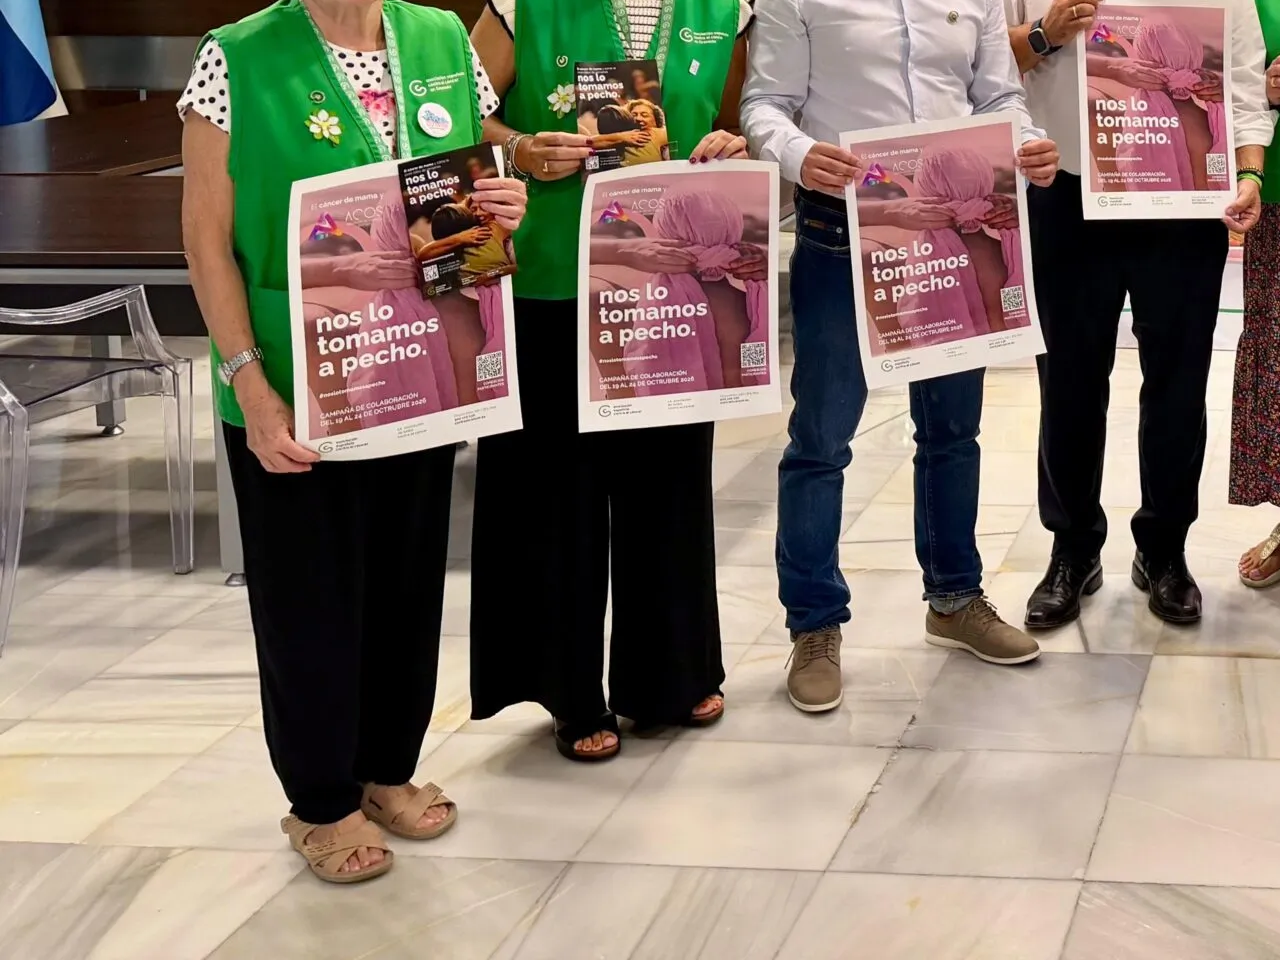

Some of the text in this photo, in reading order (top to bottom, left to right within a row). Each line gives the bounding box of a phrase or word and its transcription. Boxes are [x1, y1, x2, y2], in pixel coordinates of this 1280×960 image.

[577, 73, 606, 82] nos lo
[578, 82, 624, 91] tomamos
[587, 90, 621, 101] pecho.
[1095, 96, 1147, 111] nos lo
[1095, 113, 1178, 127] tomamos
[1096, 129, 1170, 147] a pecho.
[405, 170, 439, 185] nos lo
[407, 175, 460, 196] tomamos
[409, 187, 457, 205] a pecho.
[871, 240, 932, 263] nos lo
[872, 254, 968, 282] tomamos
[600, 283, 667, 303] nos lo
[874, 275, 960, 302] a pecho.
[316, 303, 392, 332] nos lo
[599, 303, 706, 323] tomamos
[316, 318, 436, 354] tomamos
[599, 321, 695, 346] a pecho.
[318, 343, 425, 376] a pecho.
[599, 374, 629, 382] CAMPAÑA
[638, 369, 687, 379] COLABORACIÓN
[321, 392, 418, 419] CAMPAÑA DE COLABORACIÓN
[363, 409, 372, 417] DE
